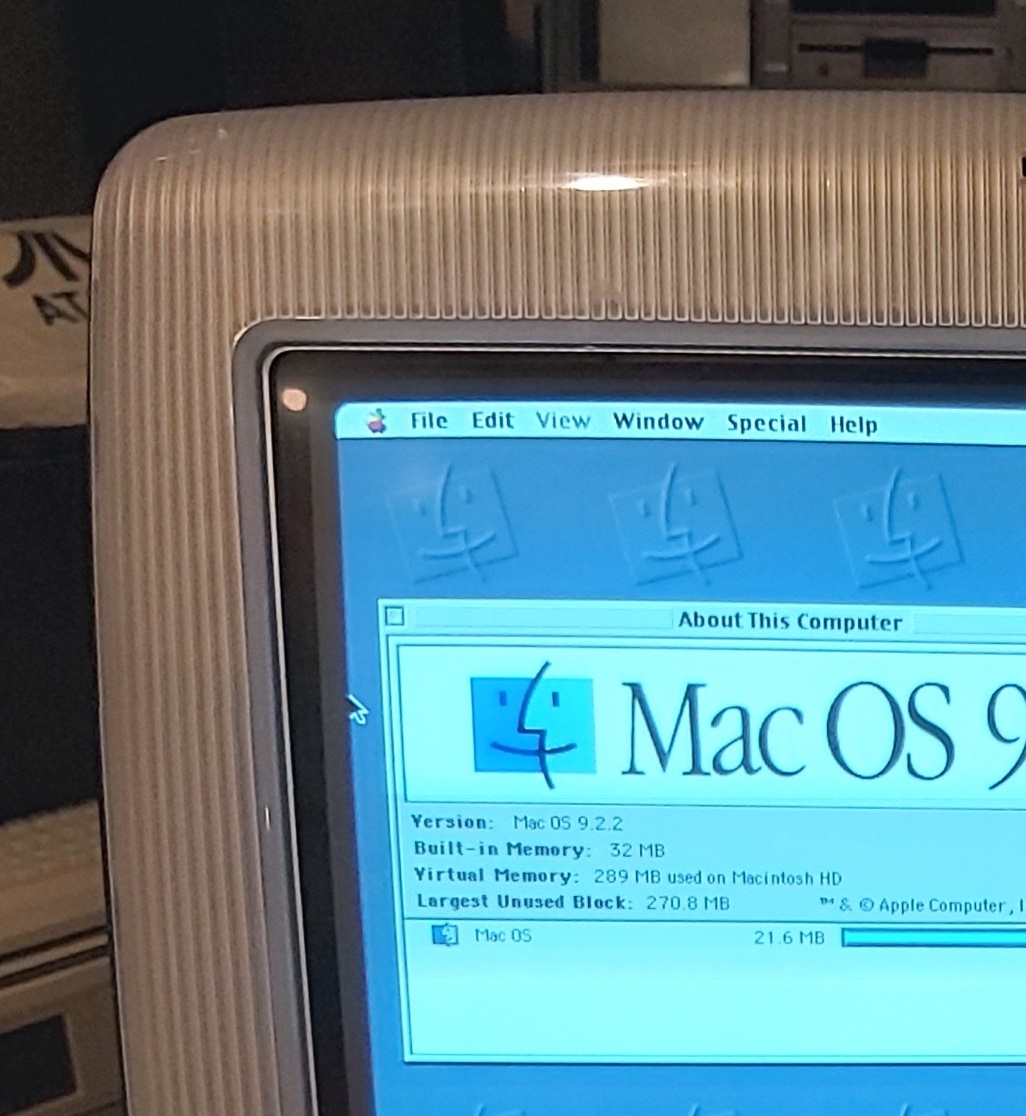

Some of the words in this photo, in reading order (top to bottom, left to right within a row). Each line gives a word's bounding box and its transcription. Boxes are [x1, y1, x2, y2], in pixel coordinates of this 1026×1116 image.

[411, 411, 448, 429] File
[472, 411, 515, 429] Edit
[535, 411, 592, 429] View
[612, 412, 705, 431] Window
[727, 413, 807, 435] Special
[830, 415, 878, 437] Help
[678, 610, 741, 629] About
[747, 612, 790, 630] This
[797, 612, 903, 634] Computer
[621, 681, 806, 777] Mac
[826, 680, 955, 781] OS
[410, 813, 493, 830] Version:
[513, 815, 545, 830] Mac
[550, 815, 572, 831] OS
[577, 815, 624, 832] 9.2.2
[414, 840, 499, 856] Built-in
[506, 841, 591, 860] Memory:
[610, 842, 633, 858] 32
[639, 843, 665, 858] MB
[413, 866, 484, 882] Virtual
[494, 867, 579, 886] Memory:
[594, 868, 629, 884] 289
[635, 869, 661, 884] MB
[667, 869, 702, 885] used
[706, 873, 726, 885] on
[732, 870, 814, 886] Macintosh
[820, 871, 842, 886] HD
[417, 893, 489, 911] Largest
[497, 894, 565, 909] Unused
[572, 895, 633, 910] Block:
[646, 895, 698, 911] 270.8
[704, 896, 730, 911] MB
[838, 896, 853, 912] &
[879, 897, 925, 915] Apple
[474, 928, 506, 943] Mac
[510, 928, 532, 943] OS
[754, 930, 794, 945] 21.6
[799, 930, 825, 945] MB
